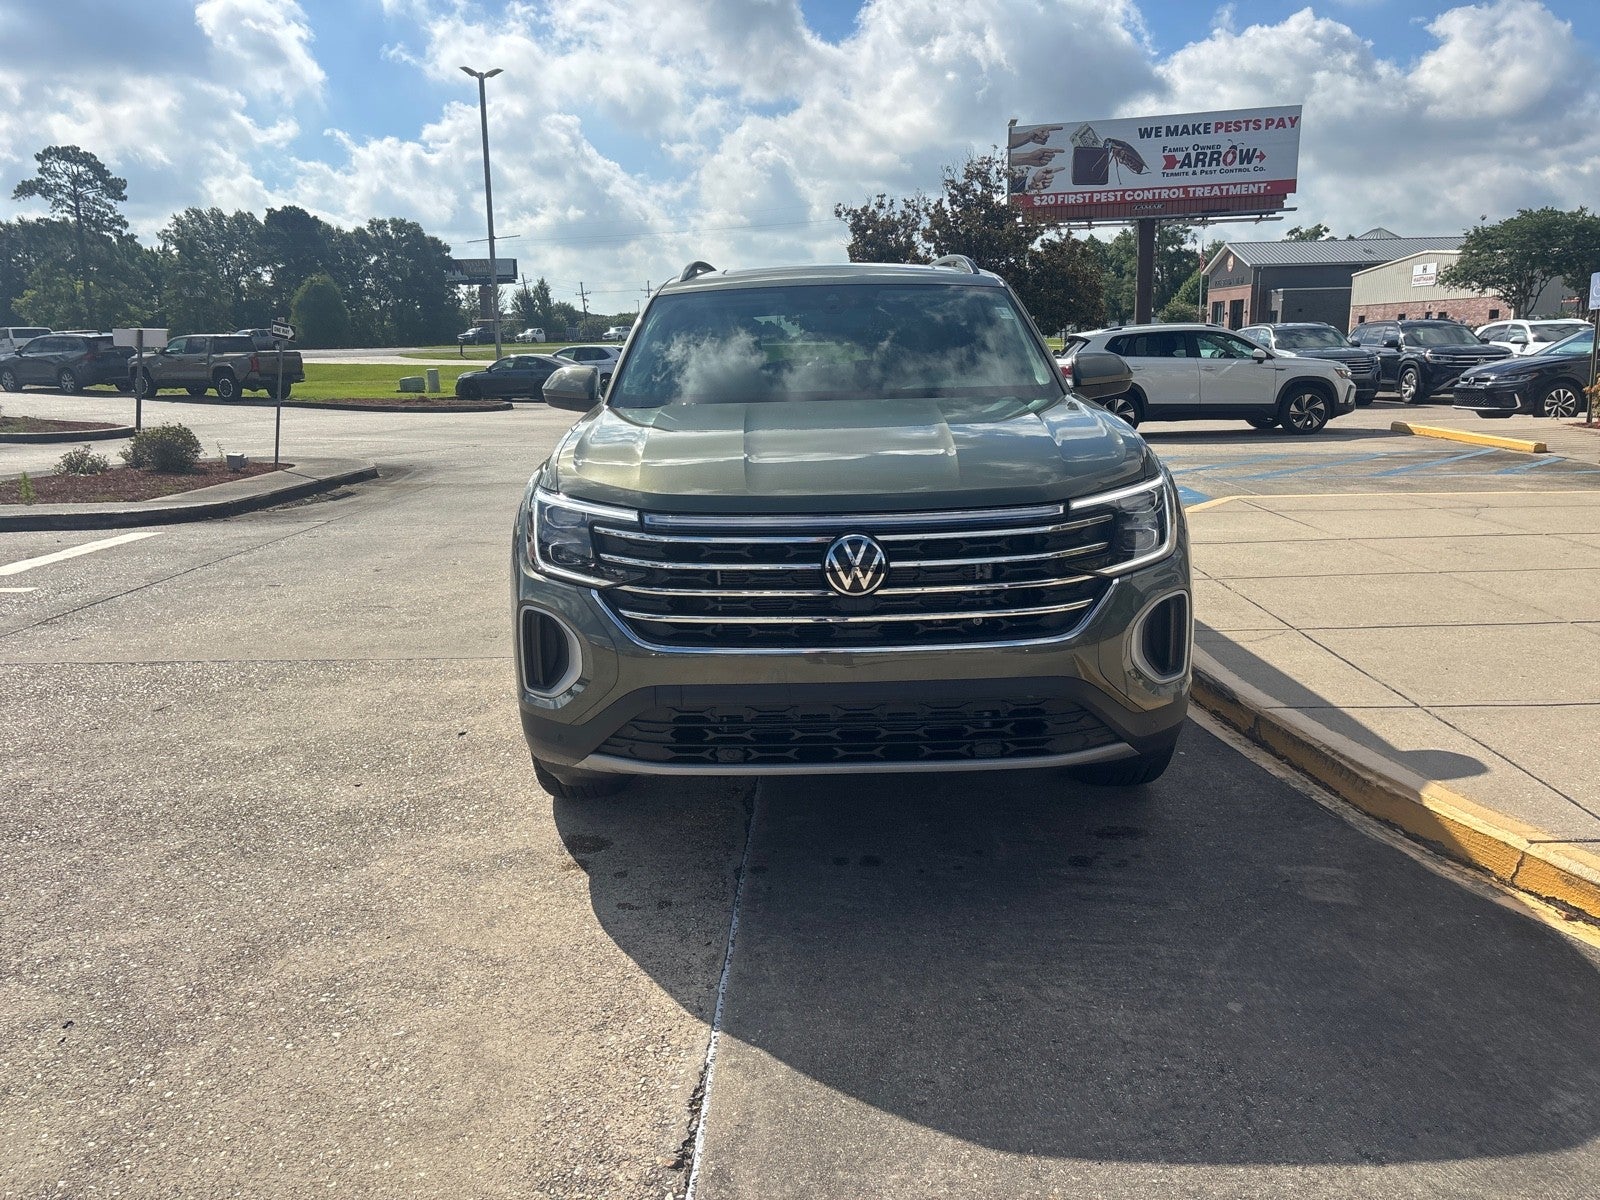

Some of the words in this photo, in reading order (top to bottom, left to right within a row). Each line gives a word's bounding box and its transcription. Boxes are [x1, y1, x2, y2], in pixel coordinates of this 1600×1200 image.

[1138, 125, 1162, 139] WE
[1165, 122, 1212, 137] MAKE
[1214, 119, 1262, 133] PESTS
[1264, 116, 1299, 130] PAY
[1162, 145, 1189, 153] FAMILY
[1192, 143, 1221, 151] OWNED
[1178, 146, 1257, 169] ARROW
[1219, 166, 1251, 174] CONTROL
[1057, 193, 1091, 204] FIRST
[1092, 191, 1123, 203] PEST
[1125, 188, 1185, 201] CONTROL
[827, 537, 883, 592] VW
